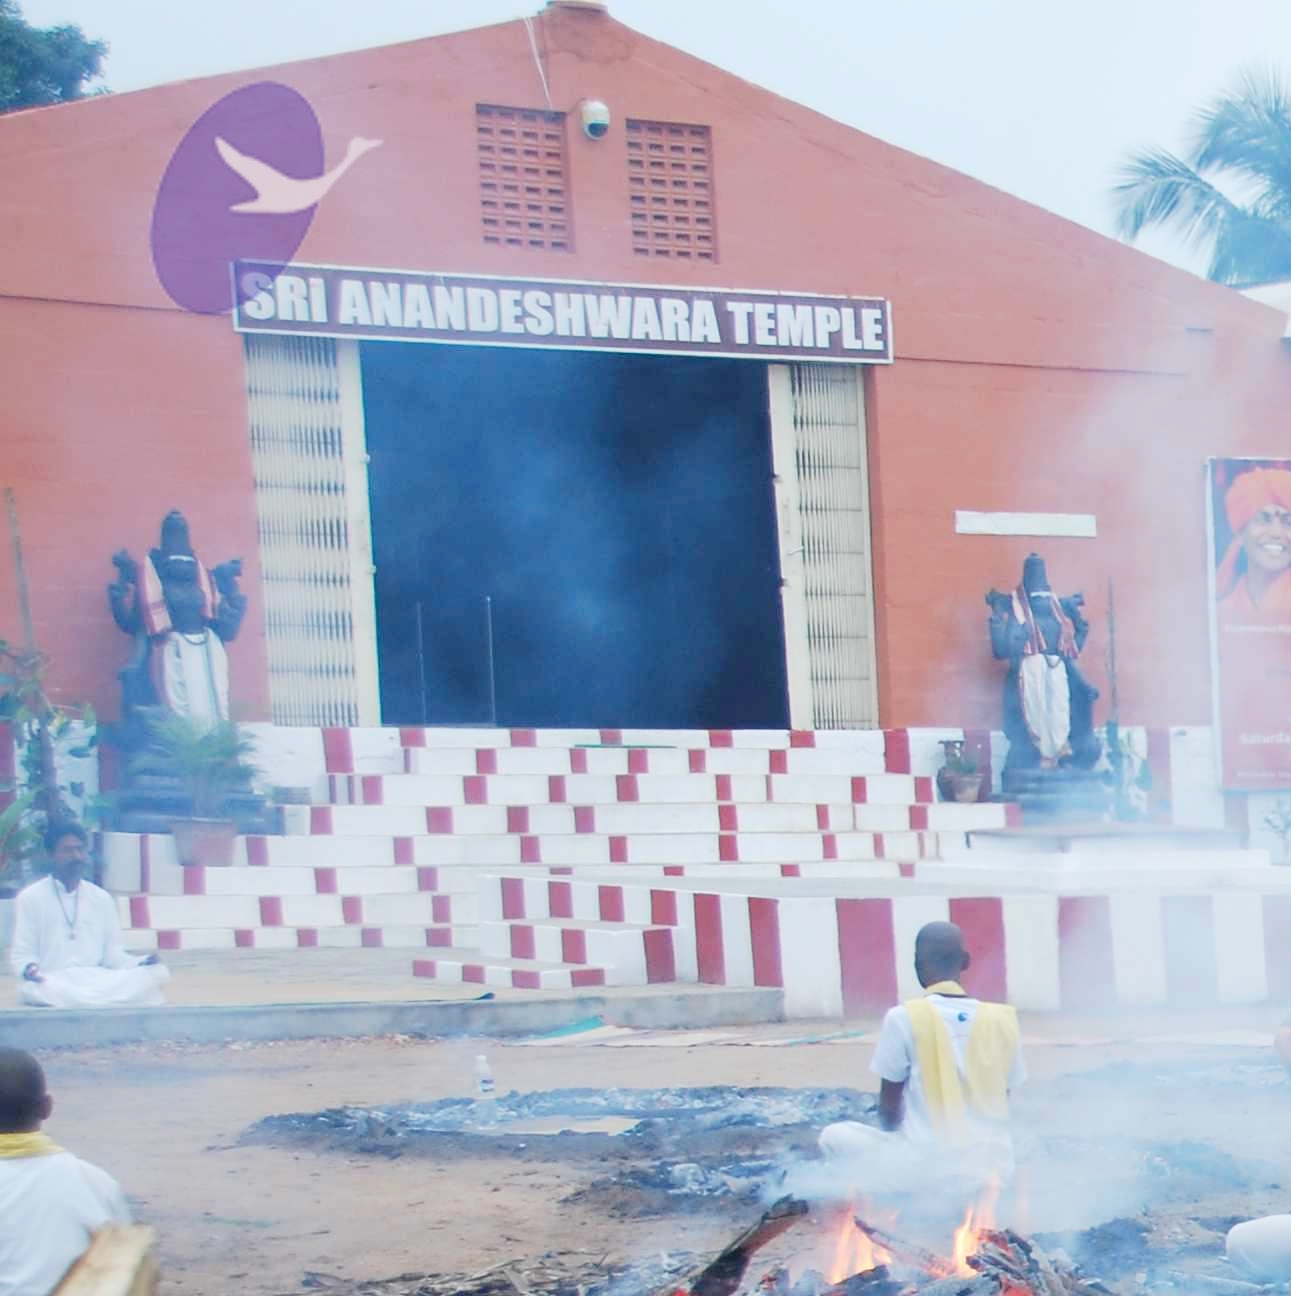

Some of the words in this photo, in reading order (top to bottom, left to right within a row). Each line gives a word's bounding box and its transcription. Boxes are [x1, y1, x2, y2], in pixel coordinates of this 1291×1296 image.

[241, 272, 327, 323] SRI
[340, 279, 720, 343] ANANDESHWARA
[727, 301, 884, 350] TEMPLE
